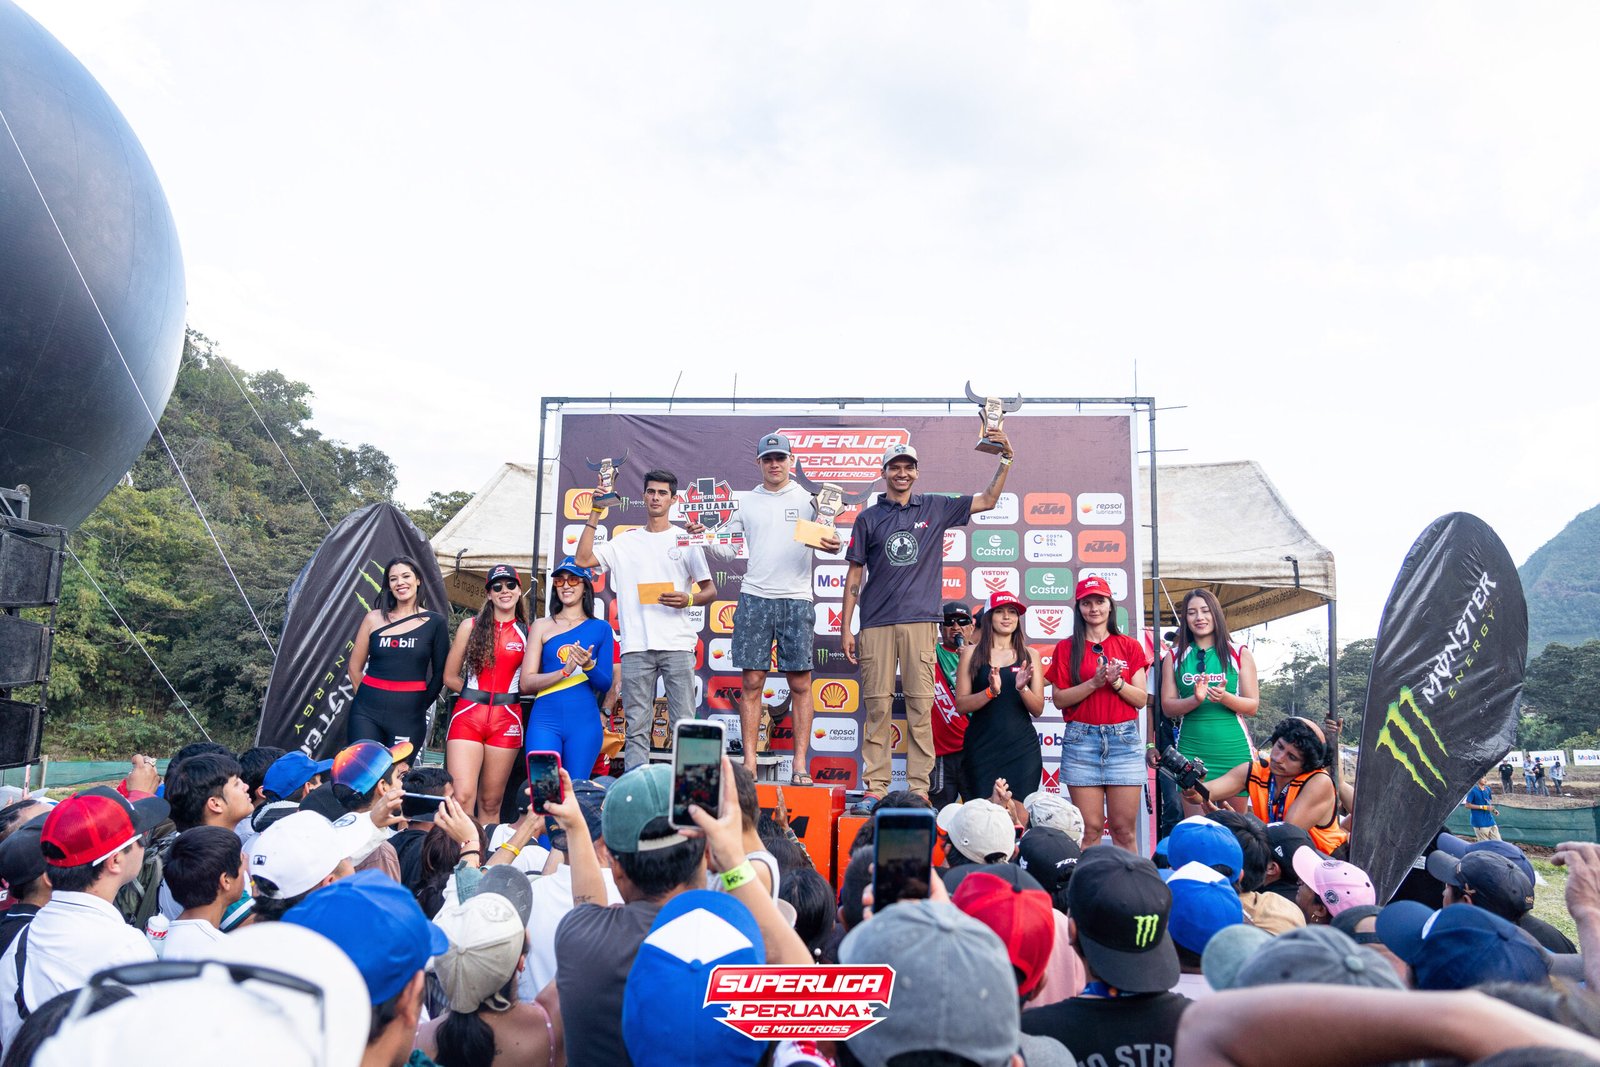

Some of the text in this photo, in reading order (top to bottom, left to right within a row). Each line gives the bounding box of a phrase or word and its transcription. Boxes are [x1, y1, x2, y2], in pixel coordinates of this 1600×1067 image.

[788, 434, 901, 449] SUPERLIGA
[797, 455, 883, 467] PERUANA
[683, 502, 735, 512] PERUANA
[1030, 503, 1066, 515] KTM
[1096, 503, 1123, 511] repsol
[914, 521, 930, 529] MX
[976, 547, 1014, 557] Castrol
[1084, 540, 1120, 553] KTM
[1029, 586, 1069, 595] Castrol
[379, 637, 416, 648] Mobil
[1420, 571, 1498, 705] MONSTER
[1449, 612, 1496, 700] ENERGY
[829, 728, 856, 738] repsol
[814, 767, 852, 781] KTM
[1055, 858, 1078, 869] FOX
